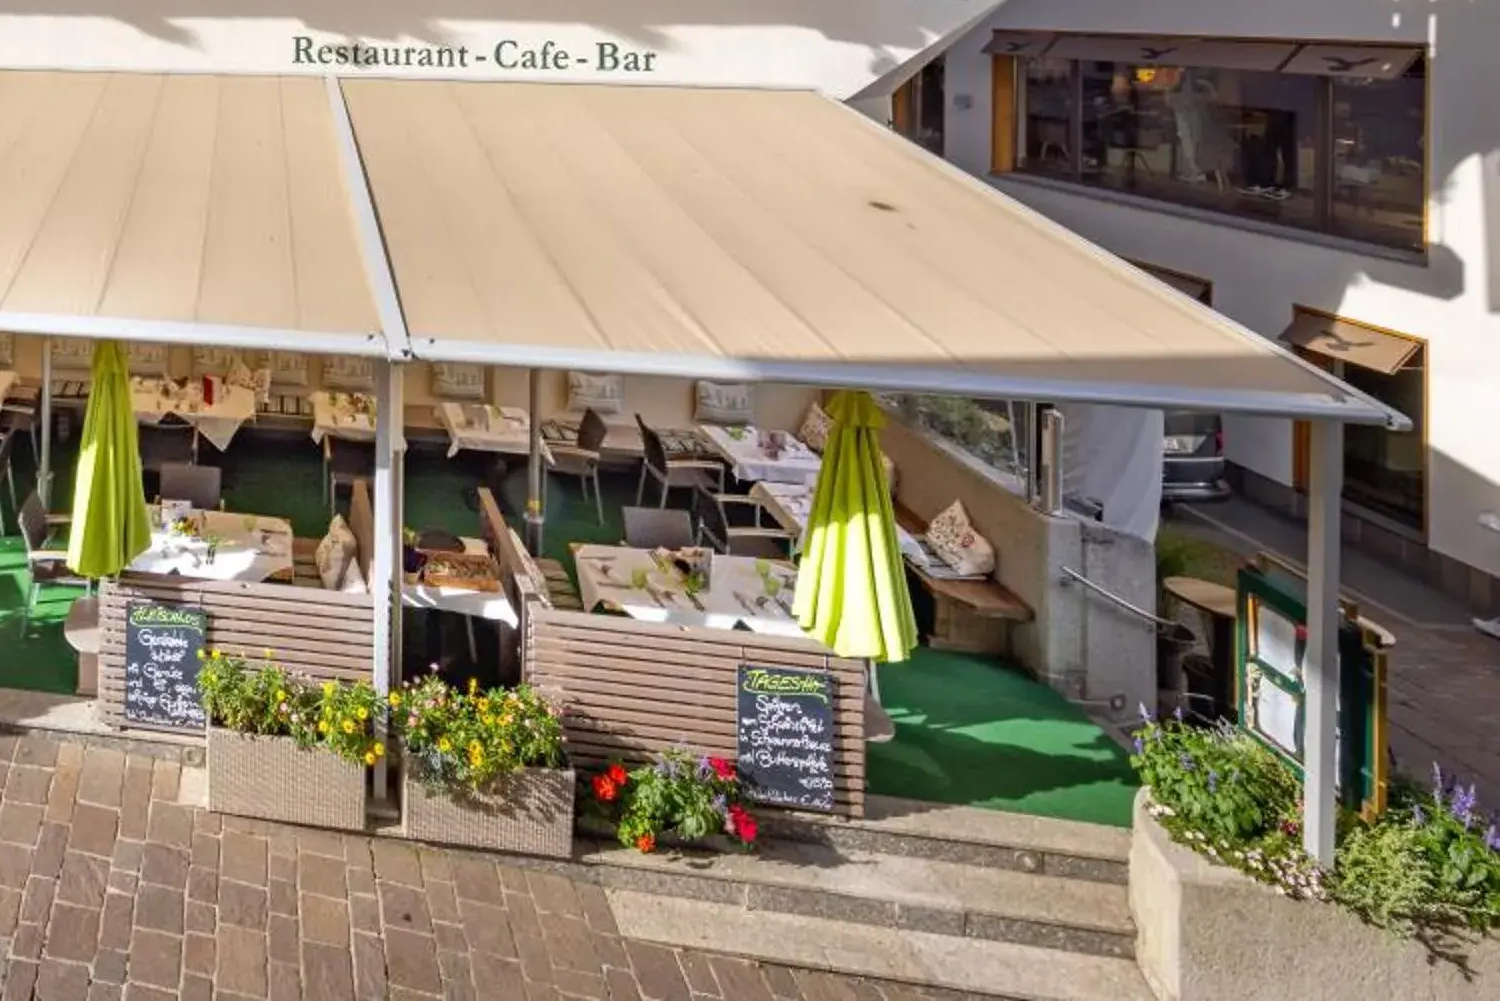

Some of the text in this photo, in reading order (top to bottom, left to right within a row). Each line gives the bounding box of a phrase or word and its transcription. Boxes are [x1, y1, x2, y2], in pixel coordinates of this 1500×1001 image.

[291, 36, 469, 68] Restaurant
[493, 39, 569, 70] Cafe
[595, 42, 657, 72] Bar
